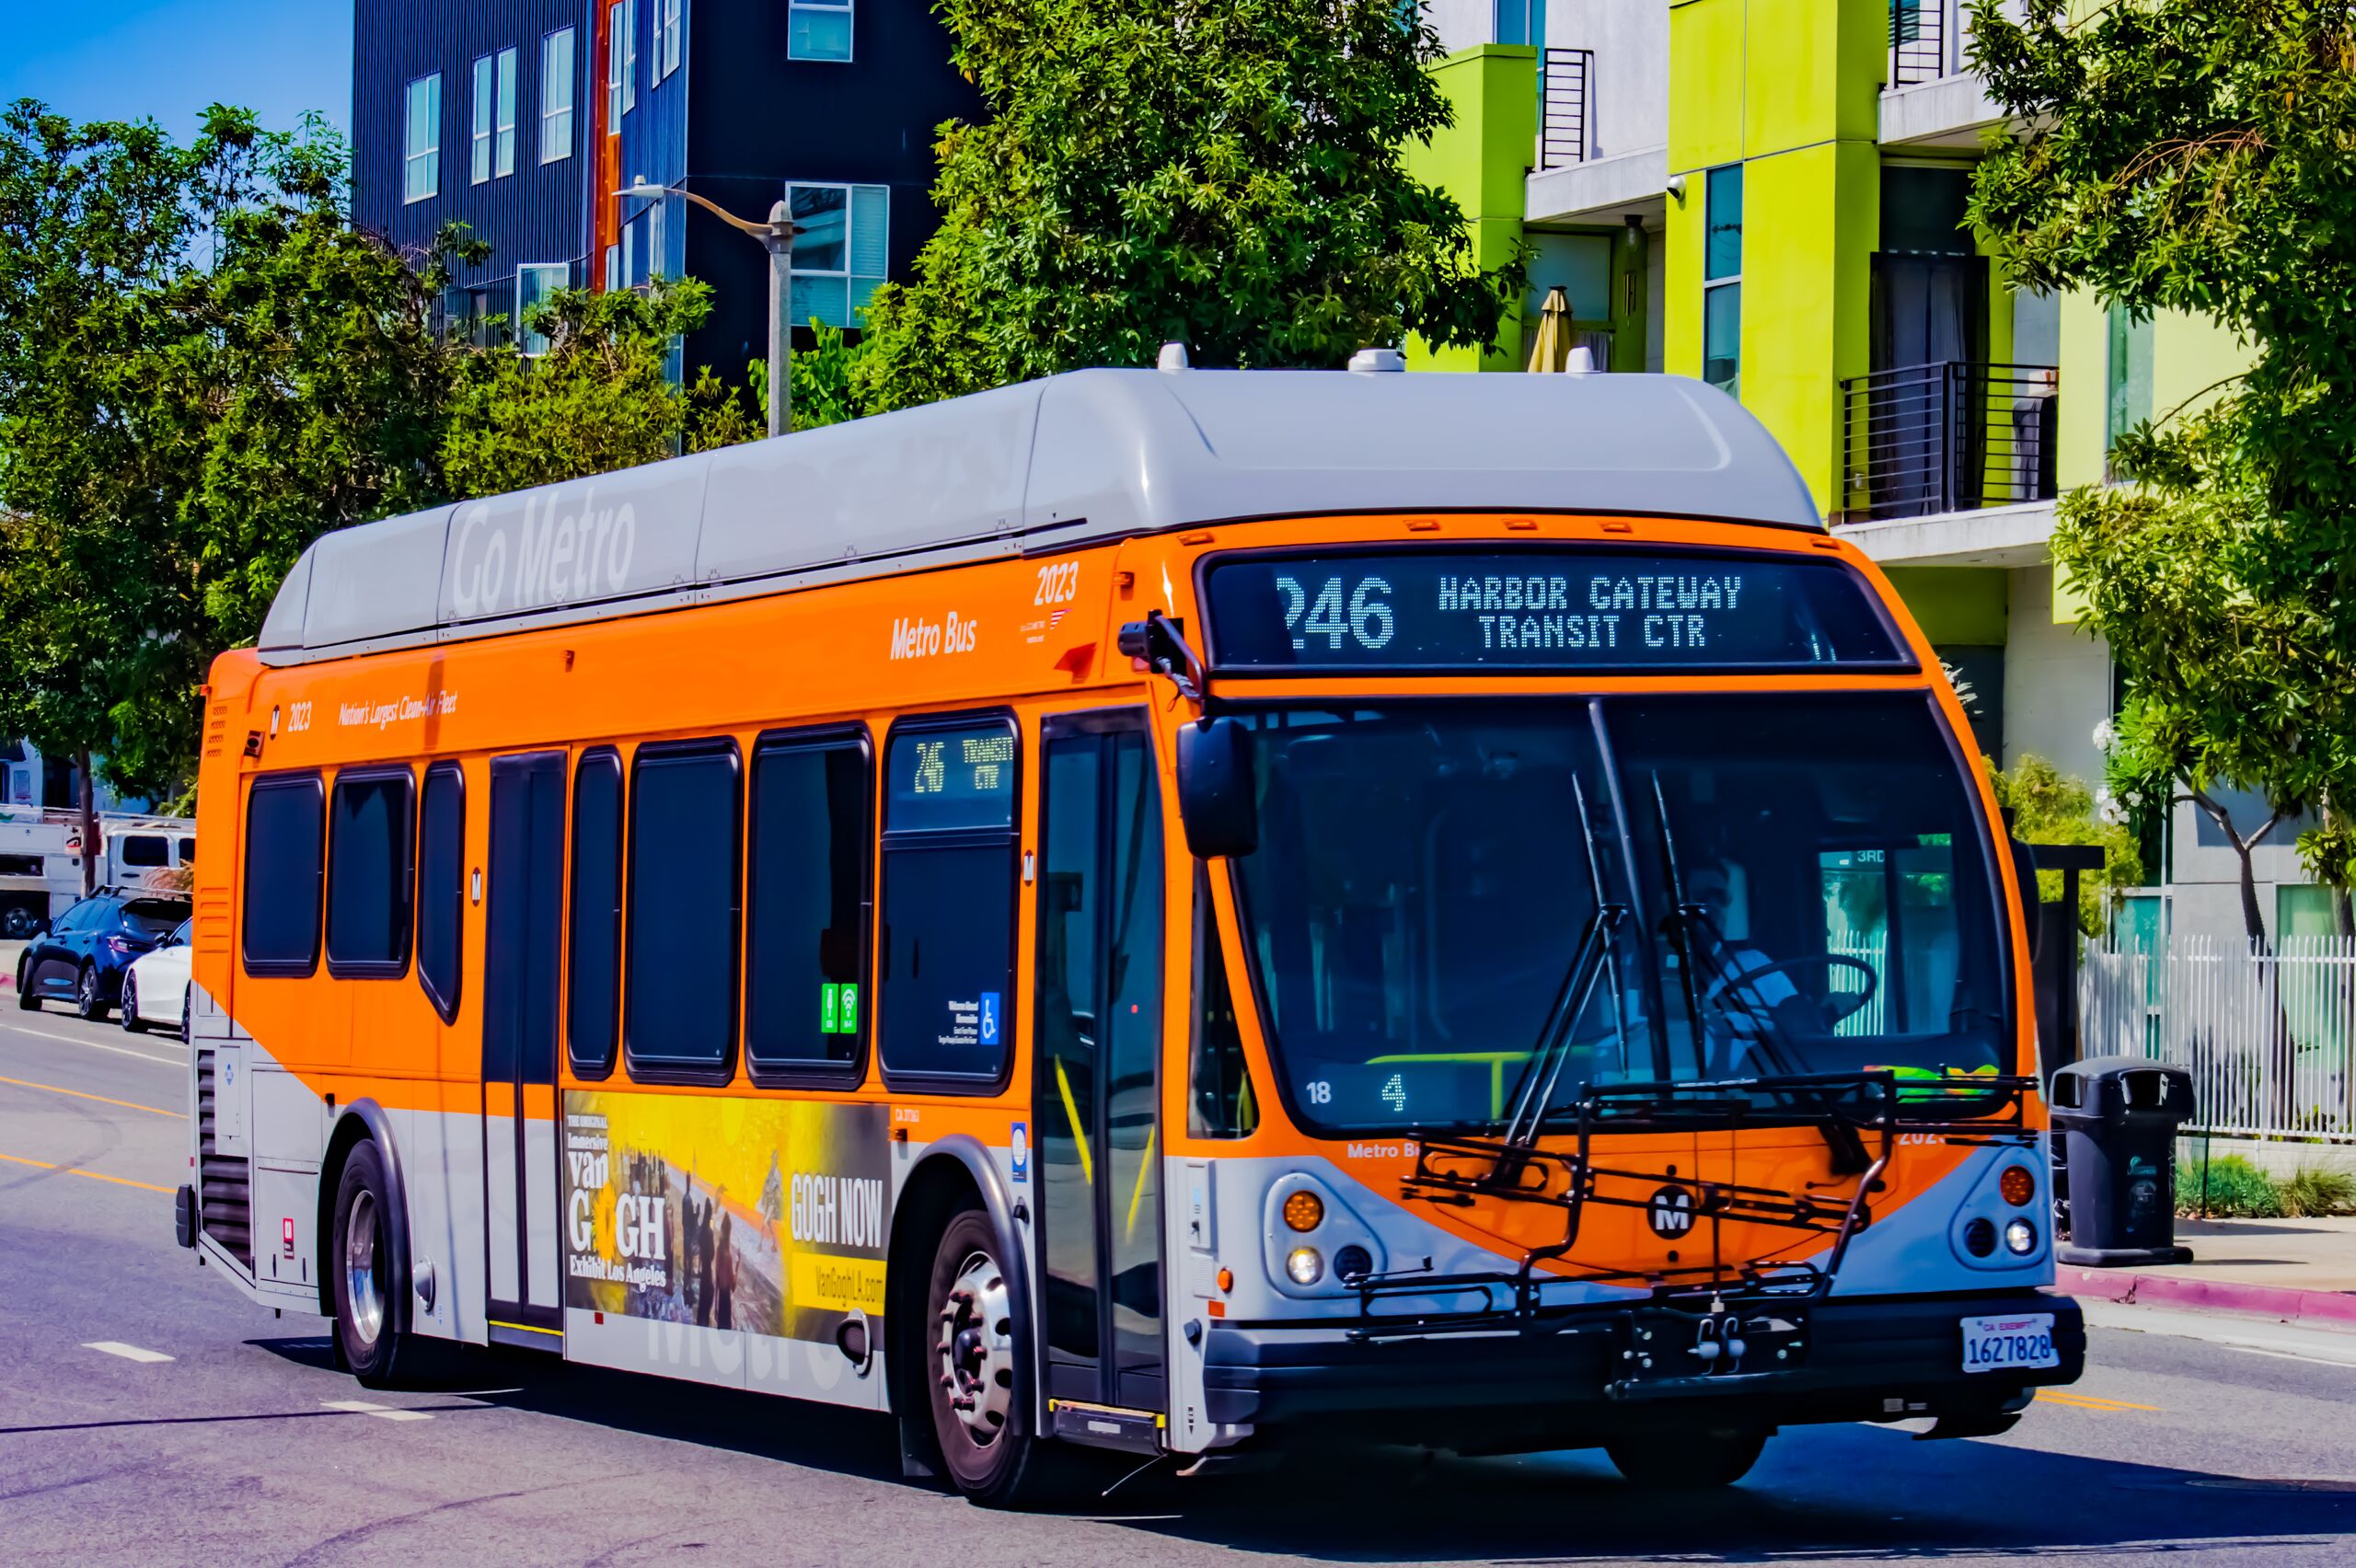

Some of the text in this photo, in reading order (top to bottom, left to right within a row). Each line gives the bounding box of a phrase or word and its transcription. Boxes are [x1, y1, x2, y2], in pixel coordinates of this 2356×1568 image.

[453, 486, 635, 617] Go Metro
[1034, 560, 1080, 606] 2023
[1438, 576, 1741, 610] HARBOR GATEWAY
[890, 611, 977, 661] Metro Bus
[1478, 614, 1705, 648] TRANSIT CTR
[287, 700, 312, 732] 2023
[338, 702, 370, 727] Nation's
[370, 698, 399, 731] Largest
[436, 690, 458, 715] Fleet
[915, 742, 945, 792] 246
[1306, 1081, 1332, 1104] 18
[1382, 1074, 1406, 1112] 4
[1347, 1143, 1399, 1158] Metro
[1899, 1133, 1946, 1146] 202
[567, 1151, 609, 1189] van
[791, 1173, 884, 1249] GOGH NOW
[1655, 1194, 1689, 1230] M
[570, 1254, 666, 1293] Exhibit Los Angeles
[815, 1265, 885, 1308] VanGoghLA.com
[1969, 1334, 2051, 1364] 1627828
